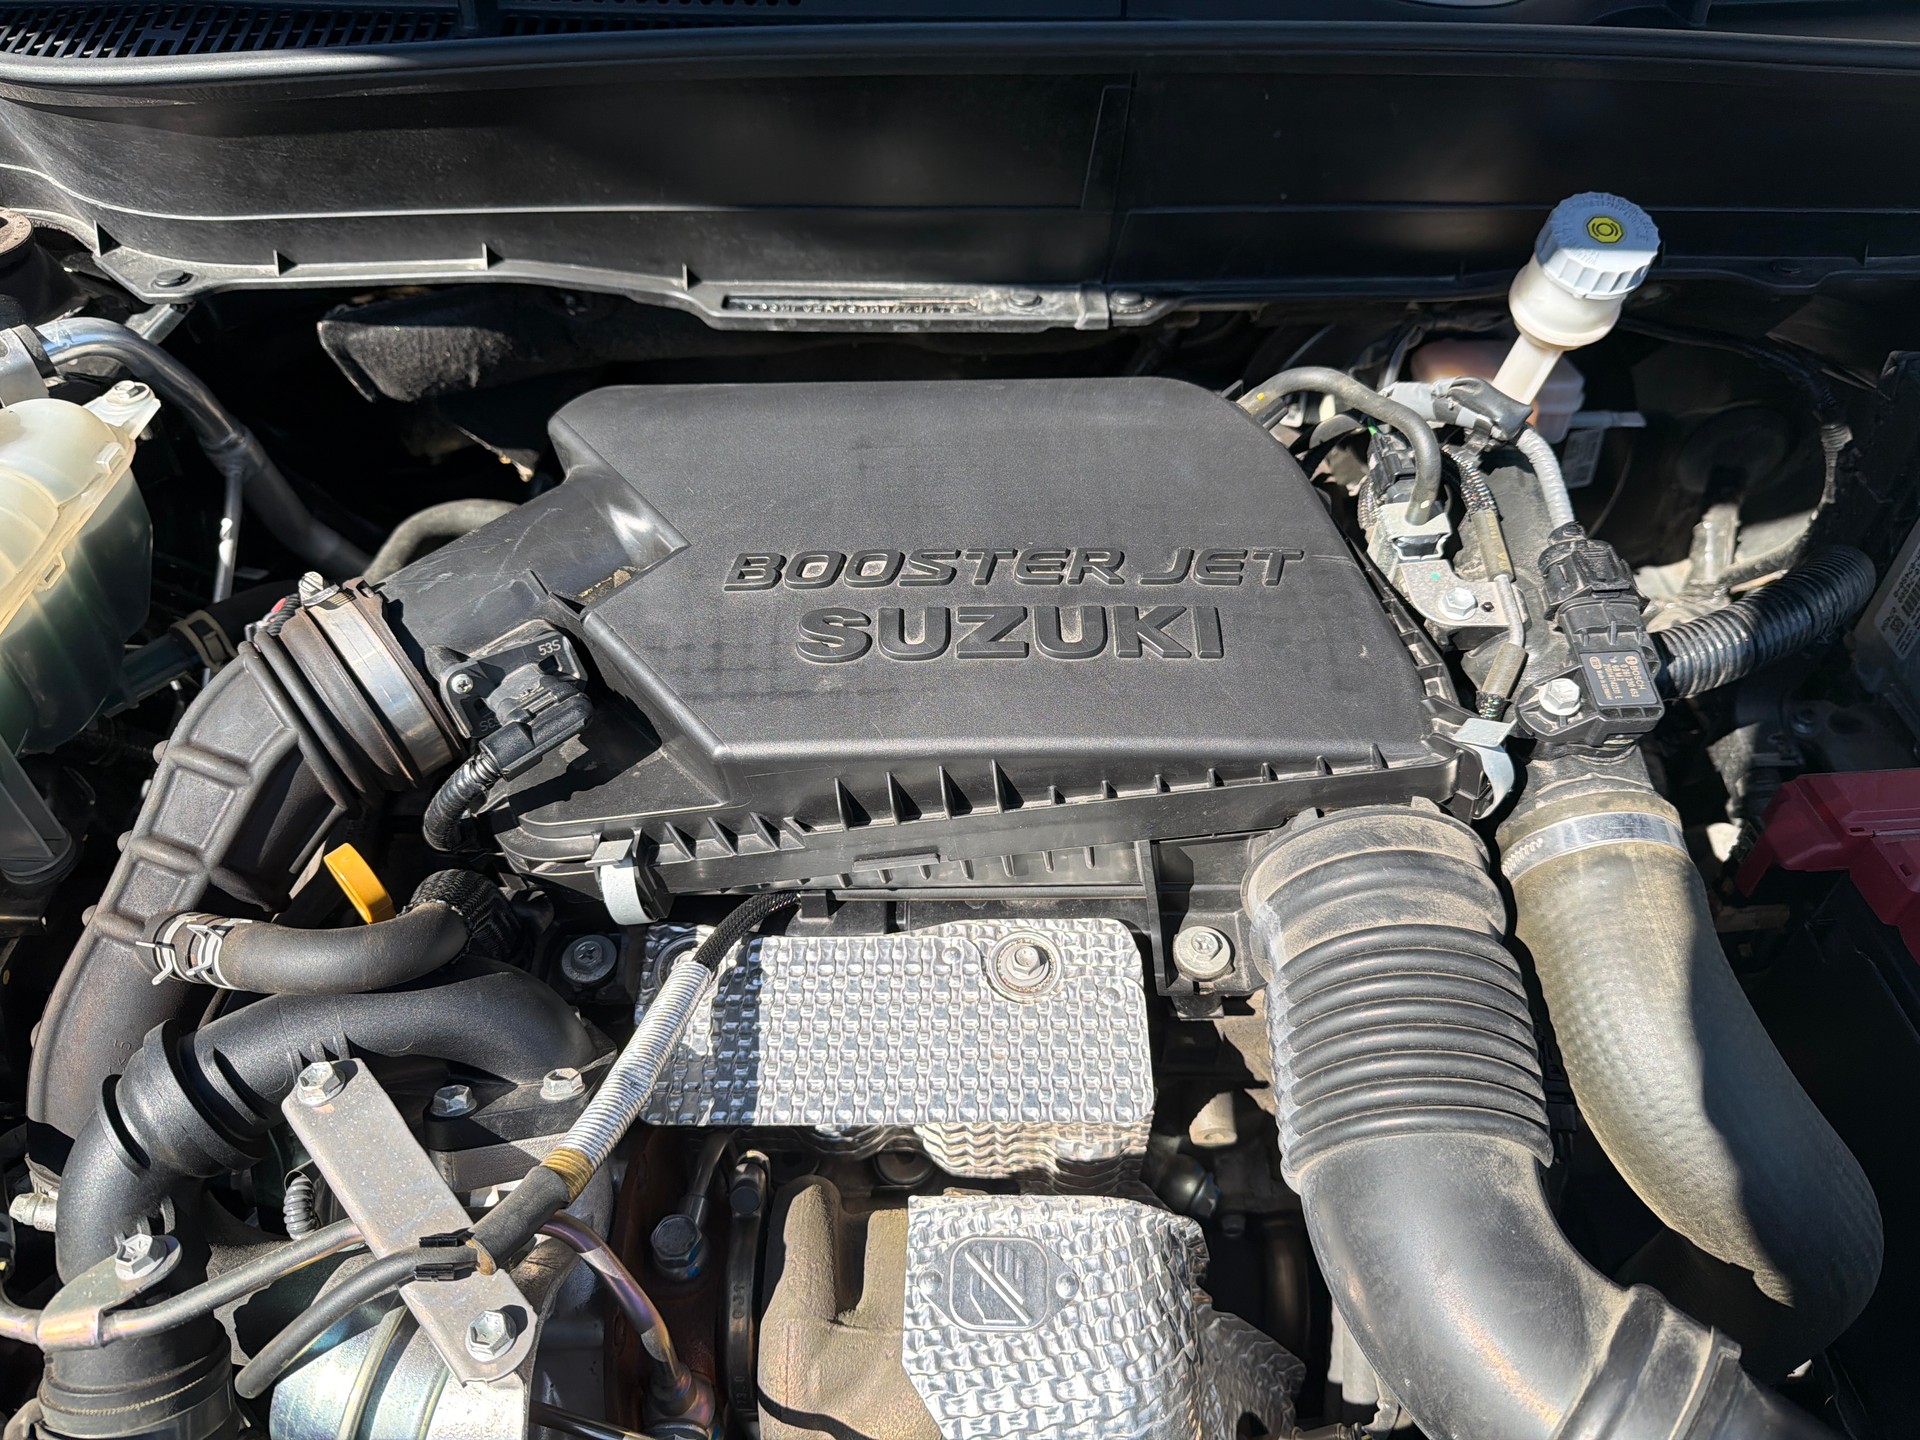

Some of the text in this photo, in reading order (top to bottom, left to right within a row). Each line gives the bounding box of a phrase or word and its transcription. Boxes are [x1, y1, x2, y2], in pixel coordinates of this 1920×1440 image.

[722, 547, 1305, 593] BOOSTER JET
[537, 639, 562, 656] 53S
[796, 604, 1226, 664] SUZUKI
[1629, 665, 1648, 691] BOSCH
